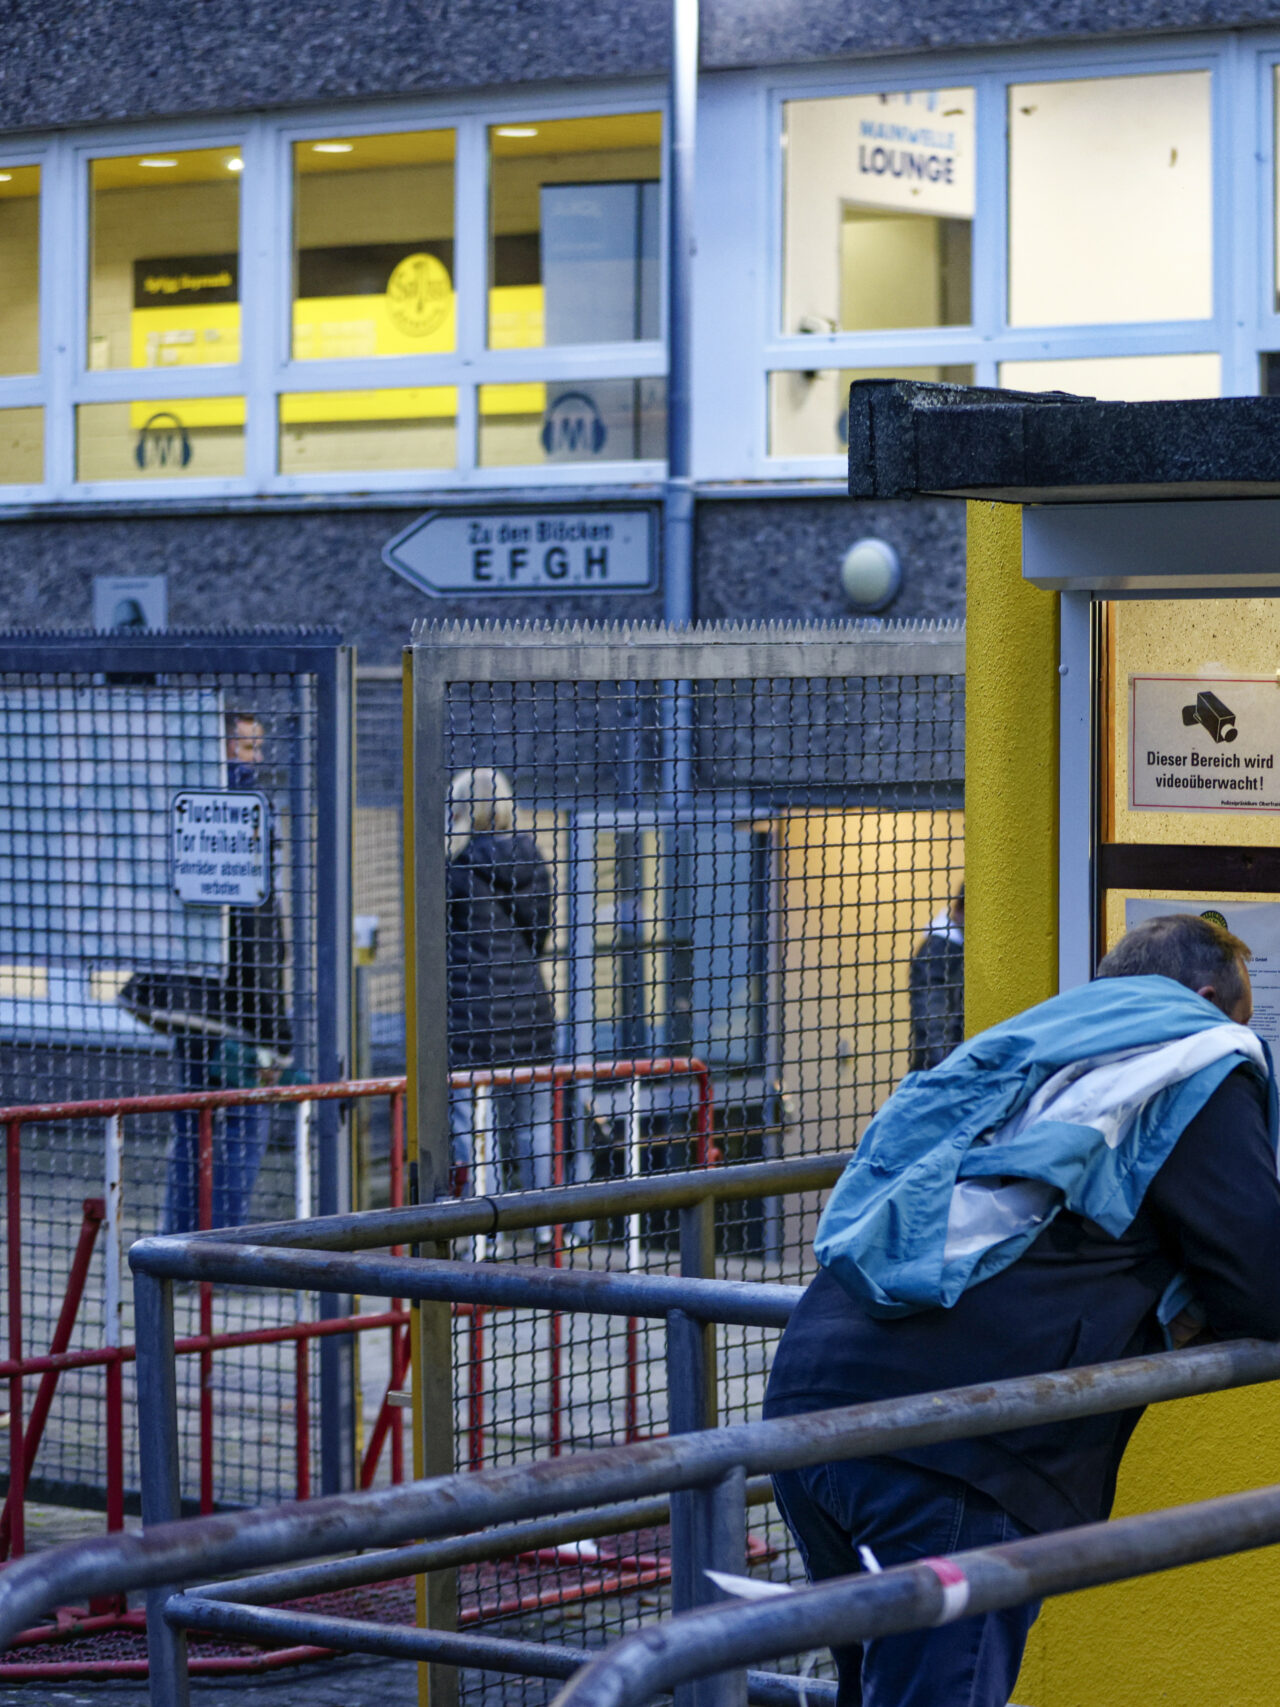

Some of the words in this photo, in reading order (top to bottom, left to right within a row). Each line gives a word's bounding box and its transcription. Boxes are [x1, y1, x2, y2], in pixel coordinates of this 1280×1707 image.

[860, 120, 955, 150] MAINWELLE
[859, 145, 954, 184] LOUNGE
[469, 521, 492, 544] Zu
[498, 520, 532, 544] den
[536, 519, 613, 543] Blöcken
[1147, 752, 1187, 766] Dieser
[1191, 753, 1240, 768] Bereich
[1244, 754, 1273, 769] wird
[177, 800, 260, 829] Fluchtweg
[177, 829, 195, 852] Tor
[200, 829, 262, 853] freihalten
[221, 861, 262, 877] abstellen
[201, 880, 240, 896] verboten
